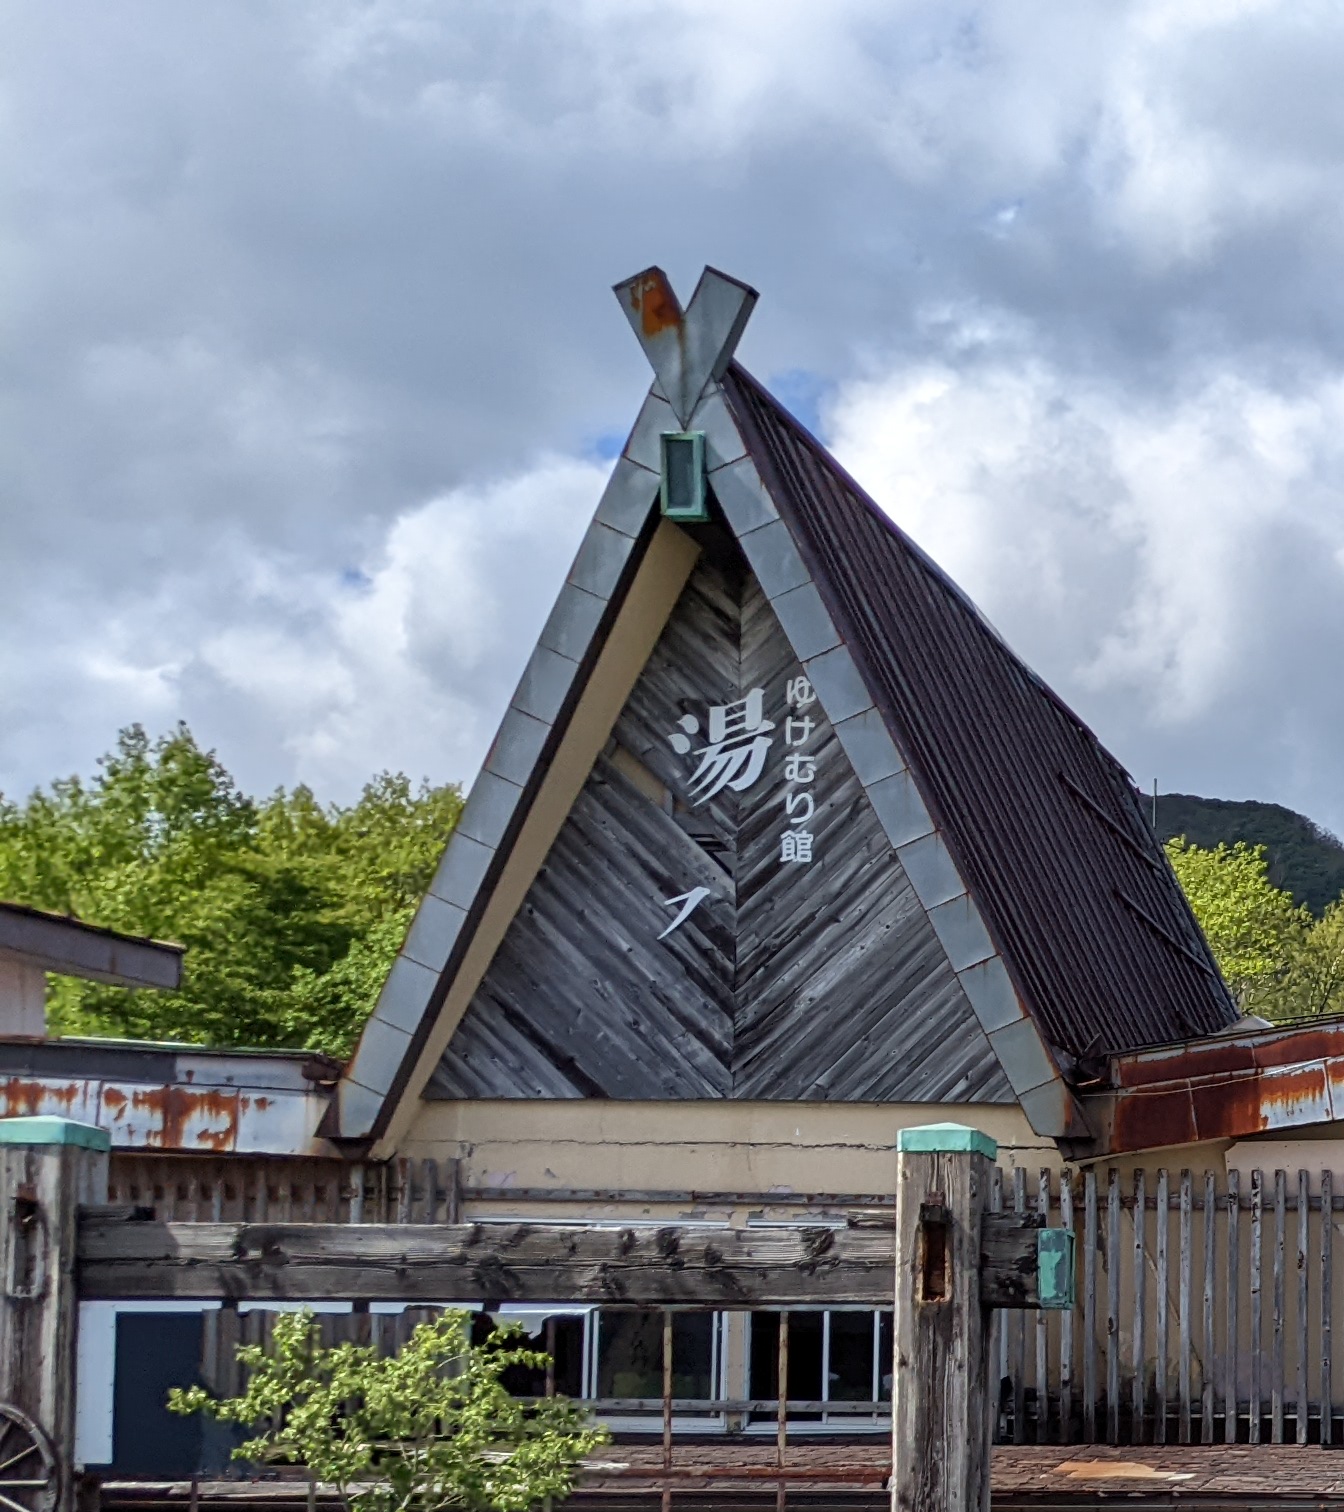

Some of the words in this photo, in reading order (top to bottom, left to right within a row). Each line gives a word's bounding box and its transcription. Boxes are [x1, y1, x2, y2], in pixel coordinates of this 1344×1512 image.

[779, 675, 818, 863] ゆけむり館
